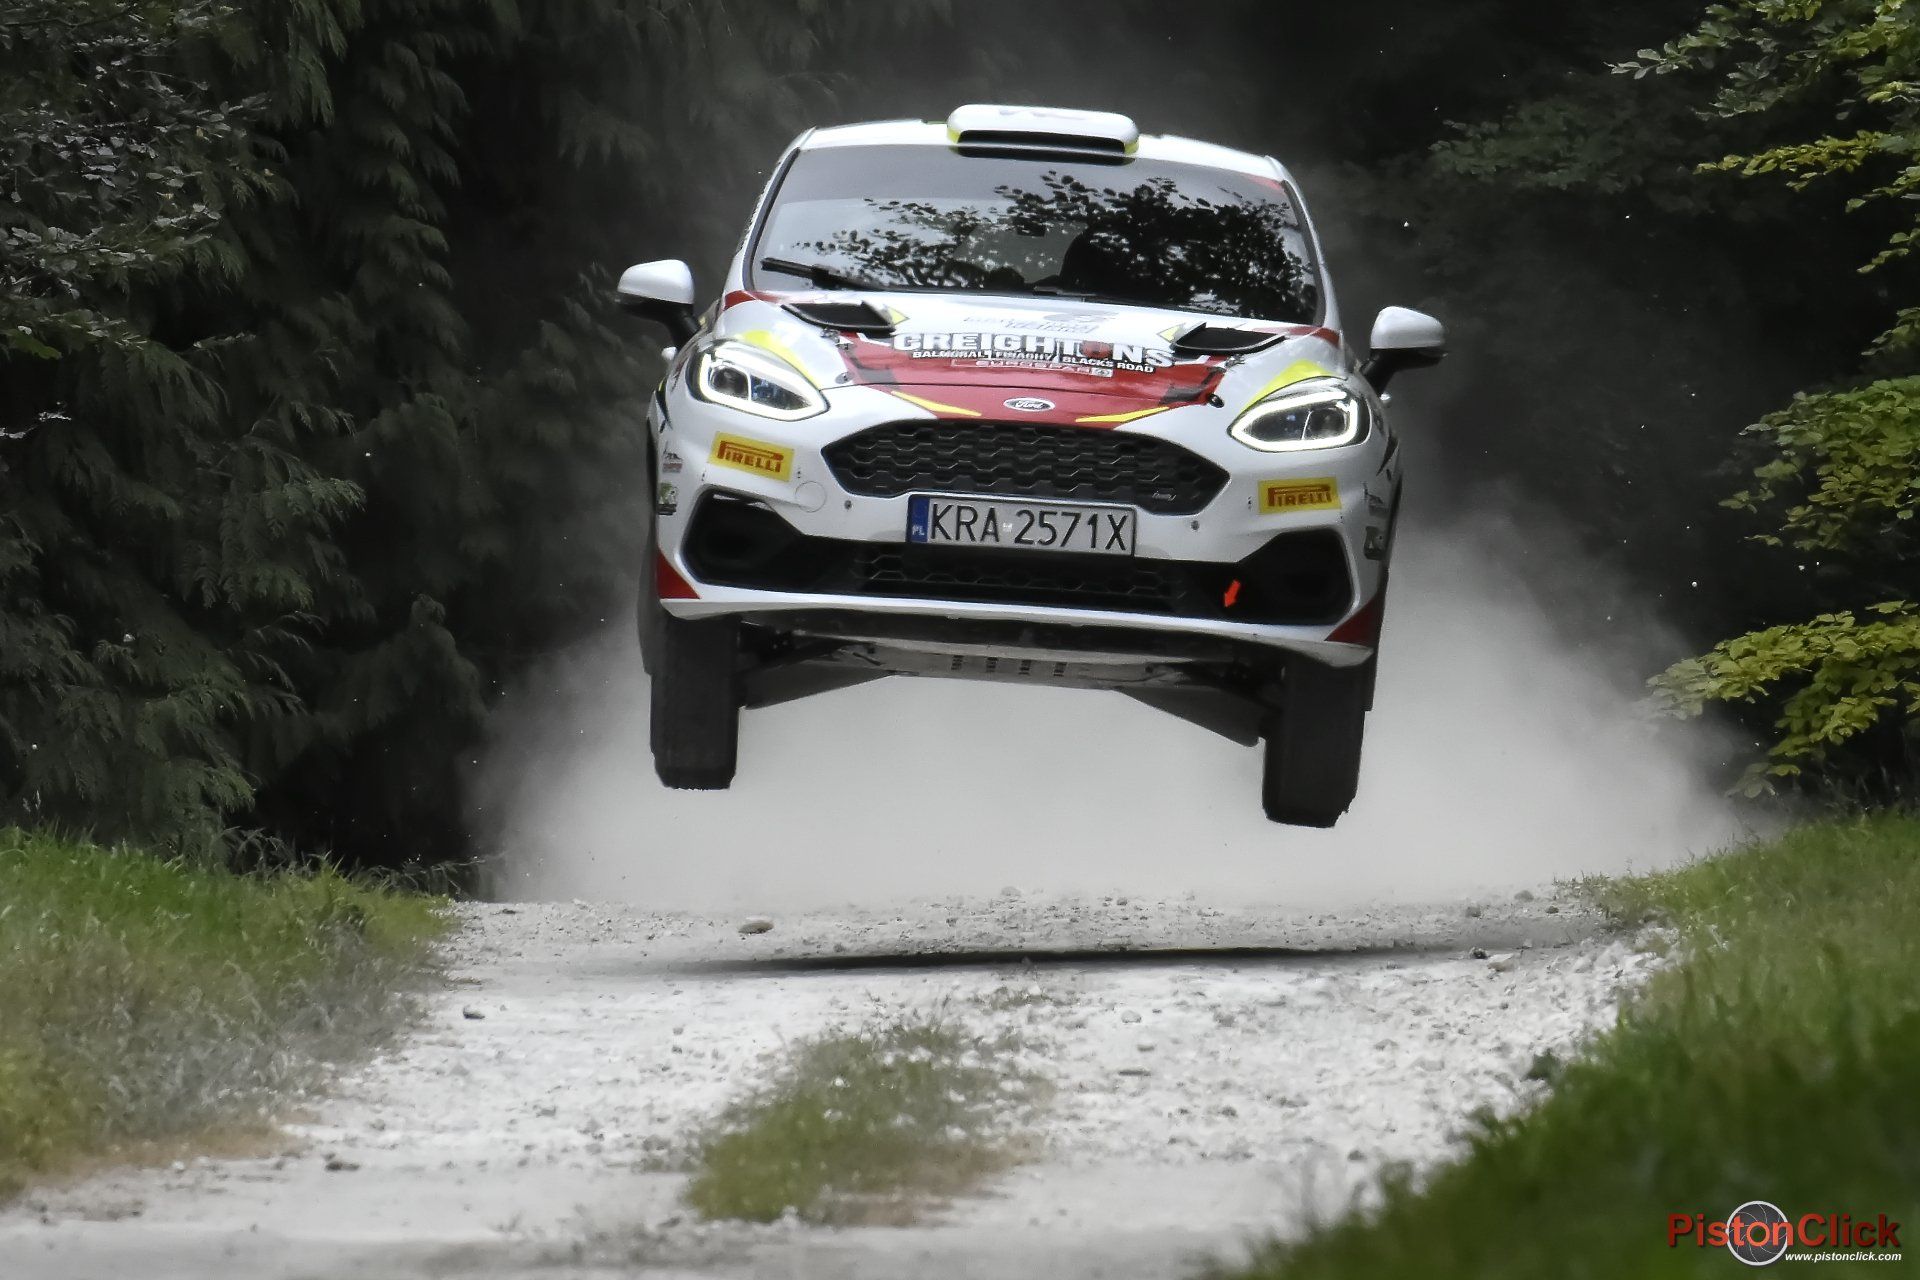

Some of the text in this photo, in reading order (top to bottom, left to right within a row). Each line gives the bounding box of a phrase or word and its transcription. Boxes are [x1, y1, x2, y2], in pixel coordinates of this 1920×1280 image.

[1116, 362, 1154, 374] ROAD
[716, 440, 785, 473] PIRELLI
[1267, 484, 1333, 507] PIRELLI
[930, 503, 1129, 551] KRA 2571X
